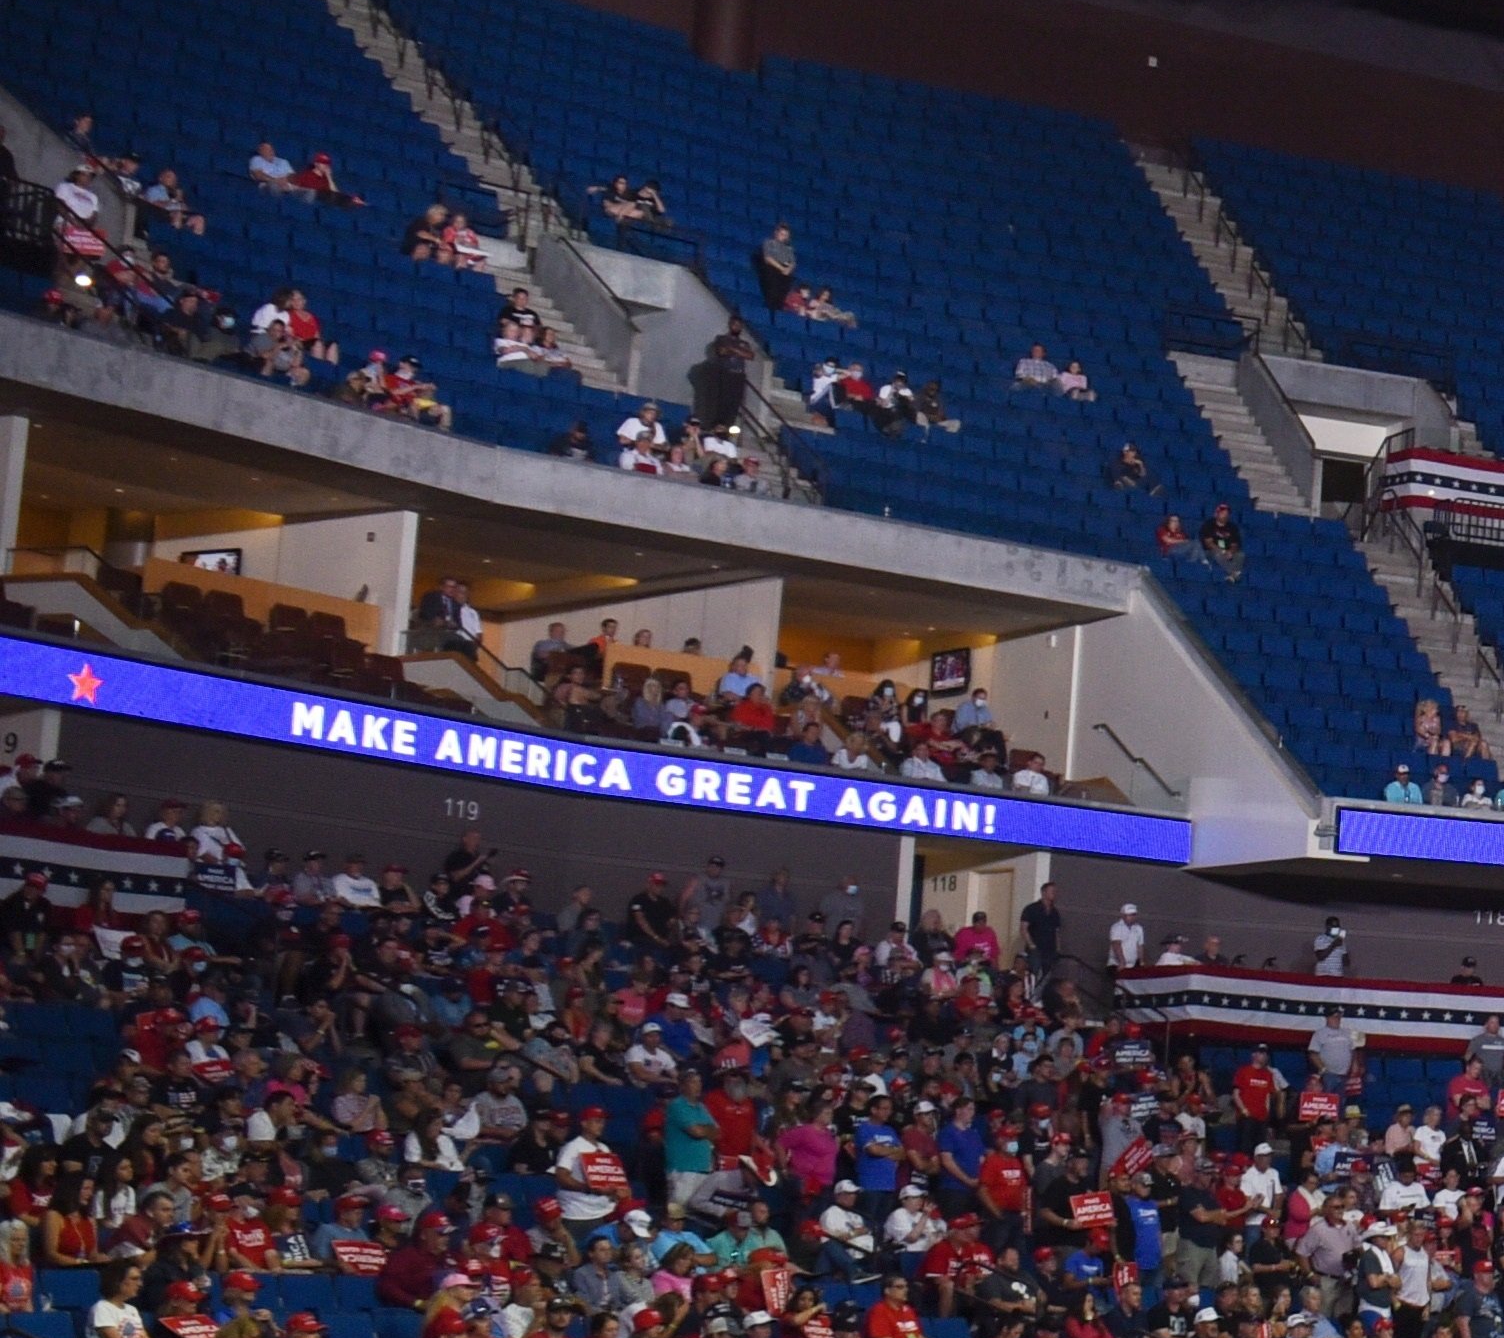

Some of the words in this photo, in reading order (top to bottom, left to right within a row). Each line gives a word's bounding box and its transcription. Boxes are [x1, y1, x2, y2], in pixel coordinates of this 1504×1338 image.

[292, 701, 416, 756] MAKE
[435, 729, 632, 791] AMERICA
[656, 764, 815, 812] GREAT
[836, 787, 996, 834] AGAIN!
[445, 797, 479, 820] 119
[932, 874, 957, 892] 118
[1076, 1202, 1112, 1216] AMERICA
